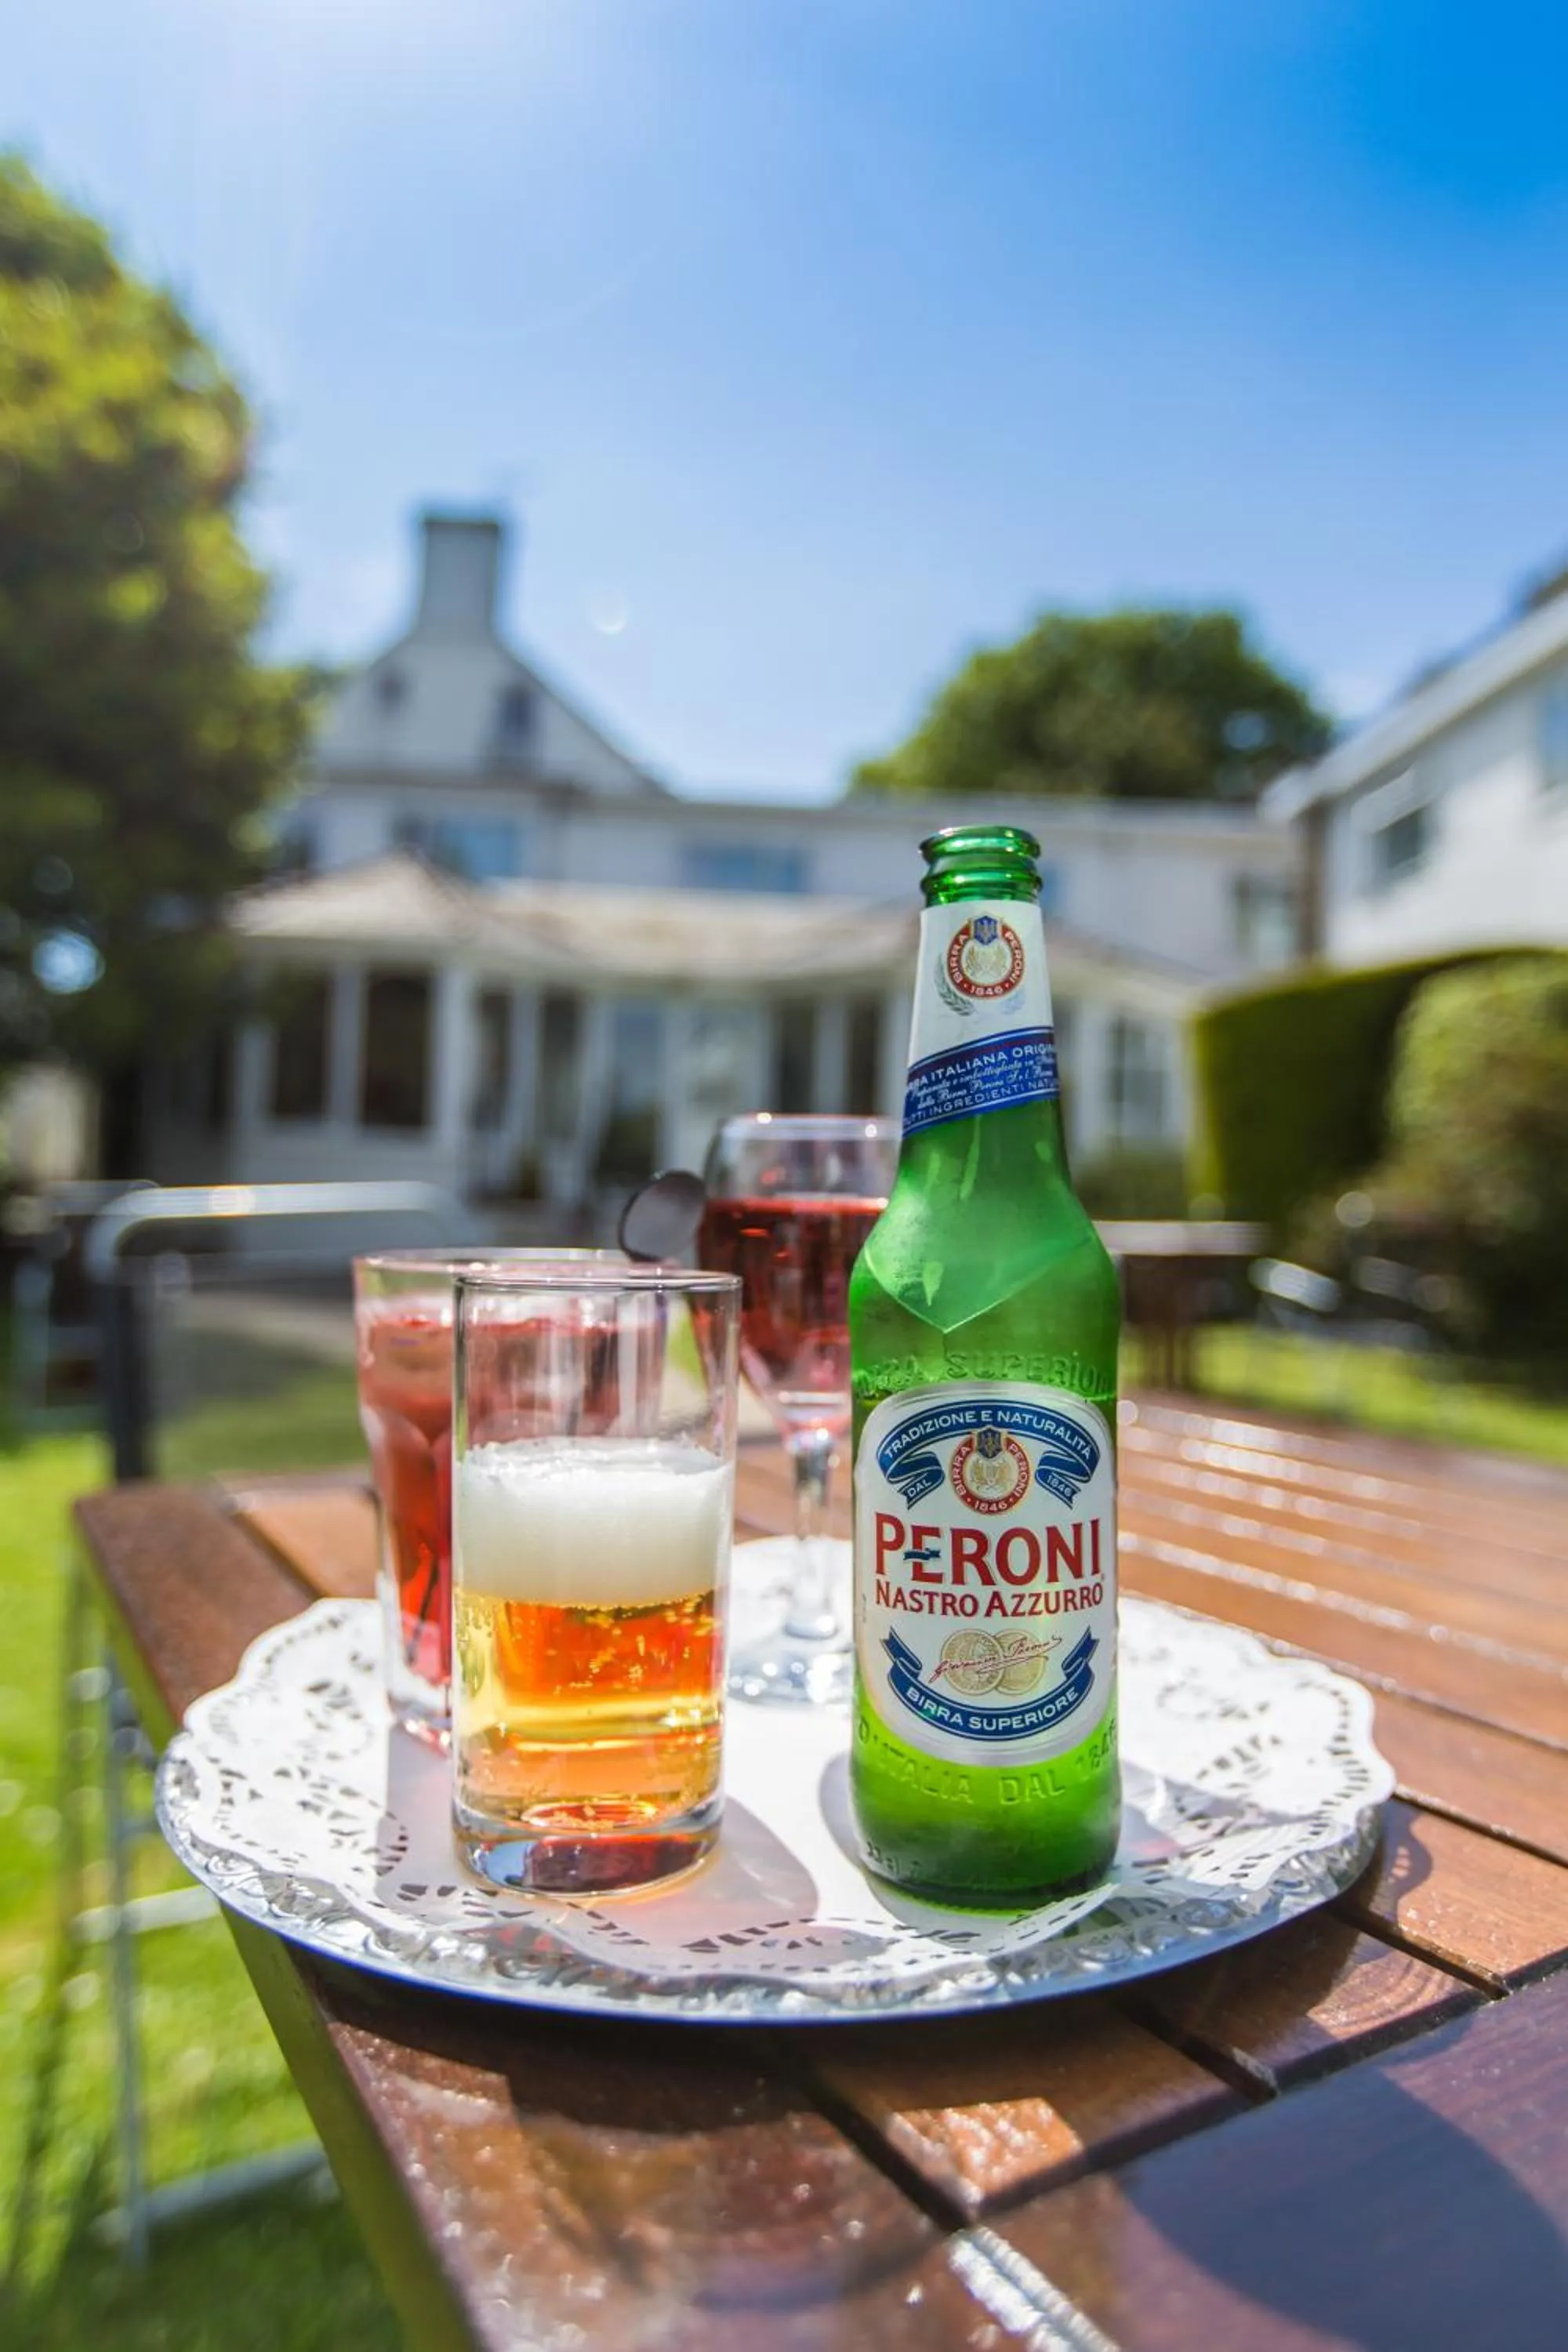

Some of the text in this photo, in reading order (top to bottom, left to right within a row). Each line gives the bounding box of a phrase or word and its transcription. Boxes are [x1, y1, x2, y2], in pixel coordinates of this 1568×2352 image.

[1004, 931, 1022, 984] PERONI
[931, 1051, 1008, 1081] ITALIANA
[929, 1082, 1025, 1116] INGREDIENTI
[884, 1410, 978, 1459] TRADIZIONE
[981, 1410, 993, 1421] E
[907, 1475, 1073, 1497] DAL 1846
[953, 1446, 971, 1496] BIRRA
[1008, 1443, 1028, 1497] PERONI
[975, 1500, 1007, 1512] 1846
[875, 1512, 1101, 1586] PERONI
[876, 1579, 980, 1617] NASTRO
[984, 1582, 1104, 1618] AZZURRO
[906, 1686, 1080, 1732] BIRRA SUPERIORE
[998, 1769, 1066, 1806] DAL
